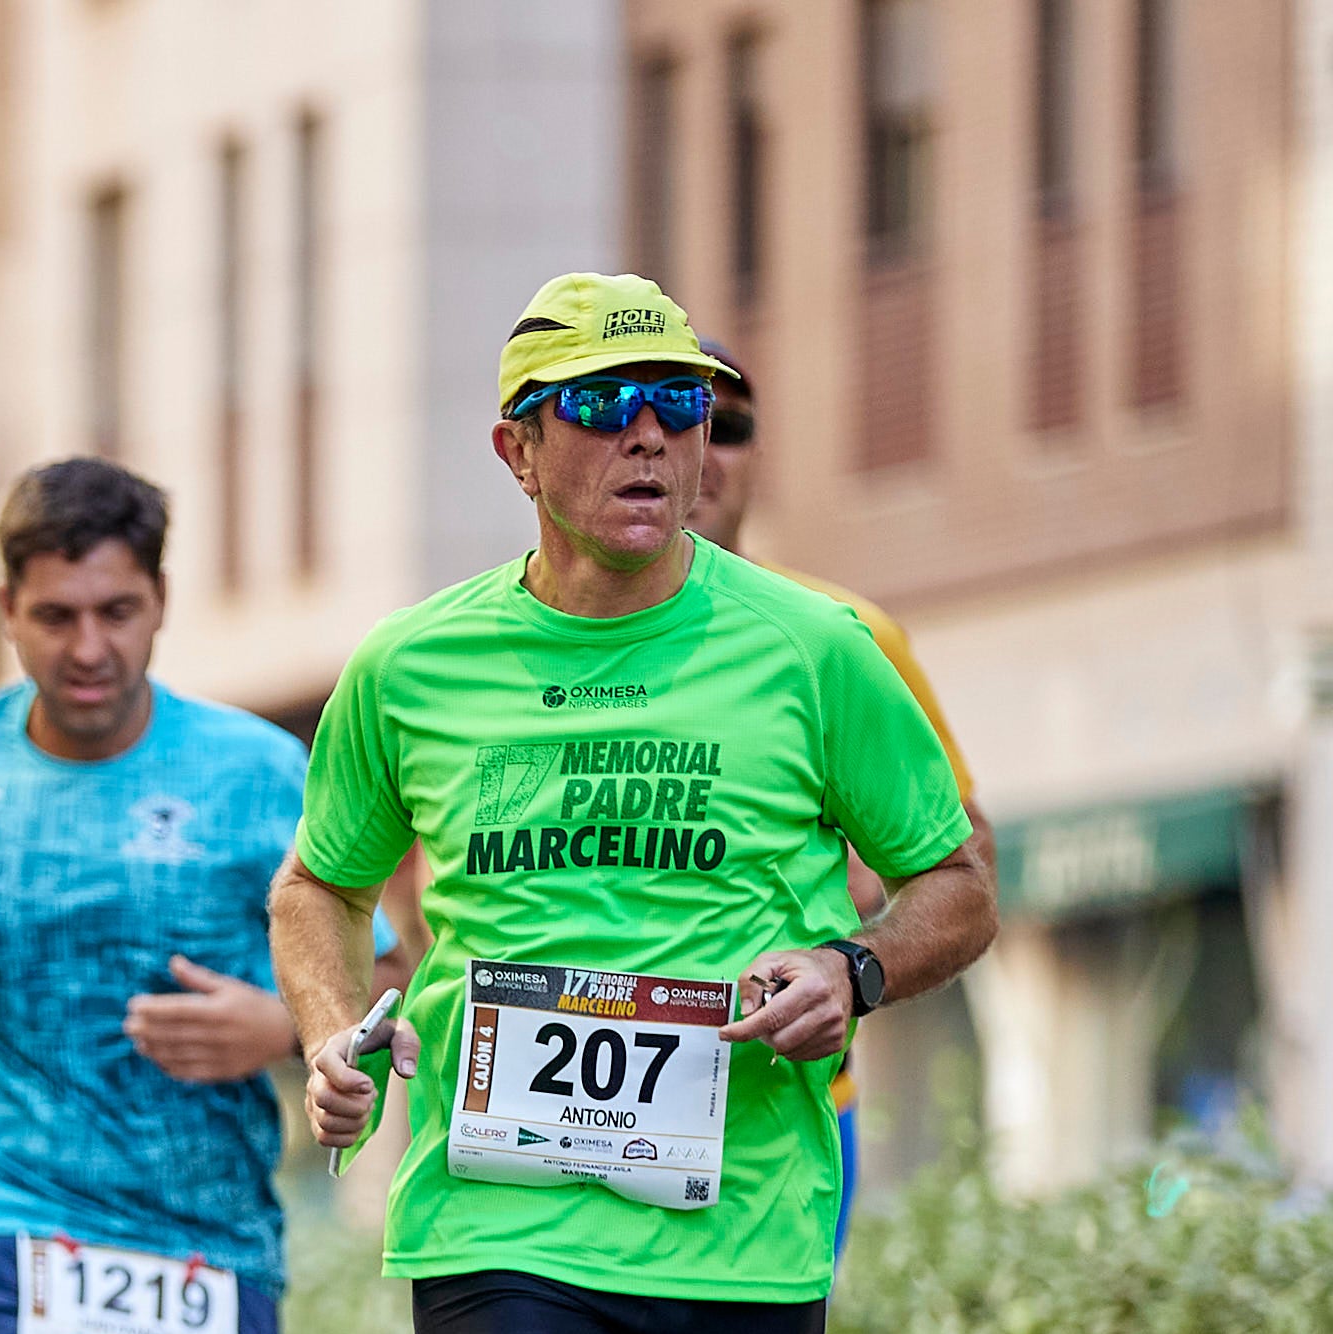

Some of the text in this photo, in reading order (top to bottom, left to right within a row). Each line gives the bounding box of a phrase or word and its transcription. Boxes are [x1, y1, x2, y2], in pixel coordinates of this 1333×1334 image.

[606, 309, 665, 330] HOLE!
[570, 685, 647, 698] OXIMESA
[568, 699, 648, 709] NIPPON GASES
[560, 740, 721, 776] MEMORIAL
[475, 743, 562, 827] 17
[561, 778, 713, 821] PADRE
[466, 825, 727, 875] MARCELINO
[494, 971, 547, 985] OXIMESA
[563, 970, 638, 996] 17 MEMORIAL
[587, 984, 634, 1002] PADRE
[671, 988, 725, 1001] OXIMESA
[557, 995, 637, 1017] MARCELINO
[473, 1025, 494, 1091] CAJÓN 4
[529, 1022, 680, 1104] 207
[559, 1106, 637, 1128] ANTONIO
[463, 1126, 507, 1138] CALERO
[574, 1137, 612, 1149] OXIMESA
[543, 1159, 571, 1167] ANTONIO
[67, 1261, 211, 1329] 1219
